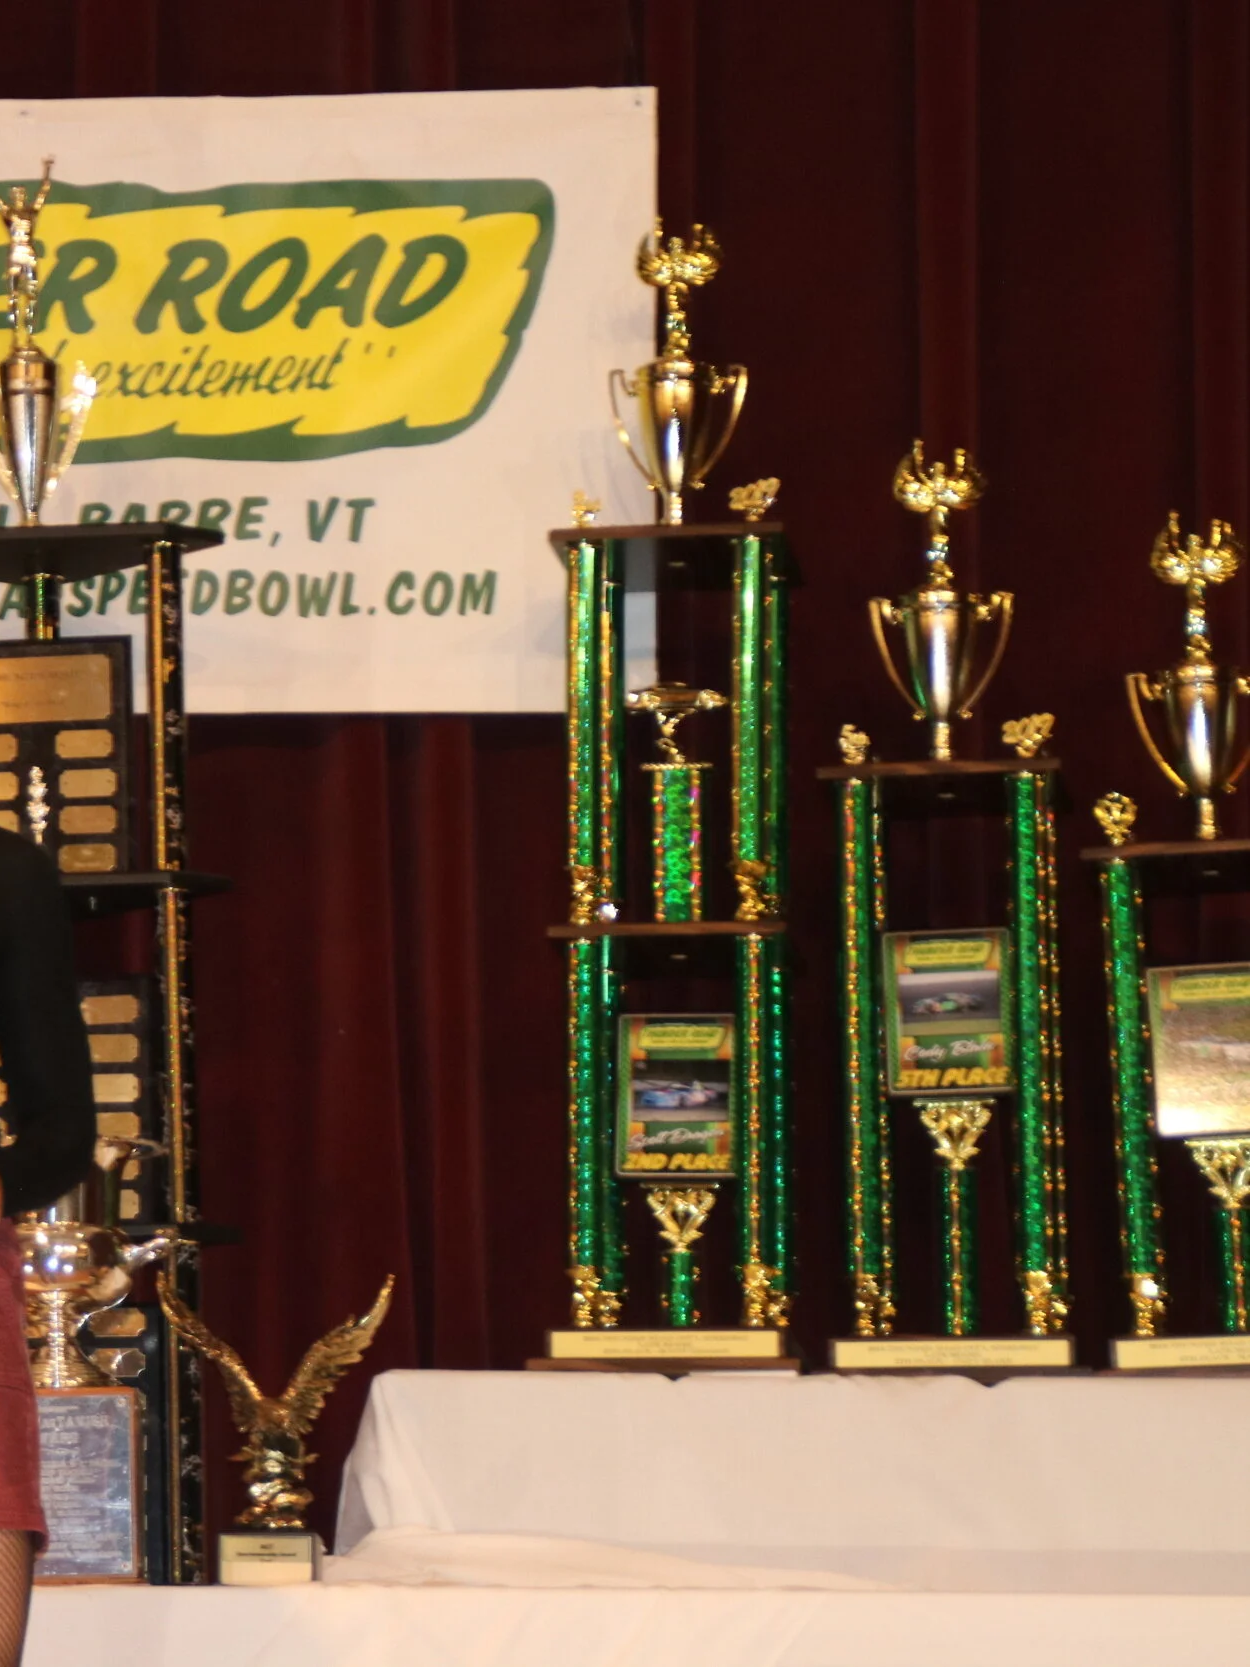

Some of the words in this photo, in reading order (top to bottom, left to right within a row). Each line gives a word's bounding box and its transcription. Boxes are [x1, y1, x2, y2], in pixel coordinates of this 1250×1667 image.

[134, 232, 468, 335] ROAD
[306, 497, 375, 543] VT
[940, 1066, 1011, 1087] PLACE
